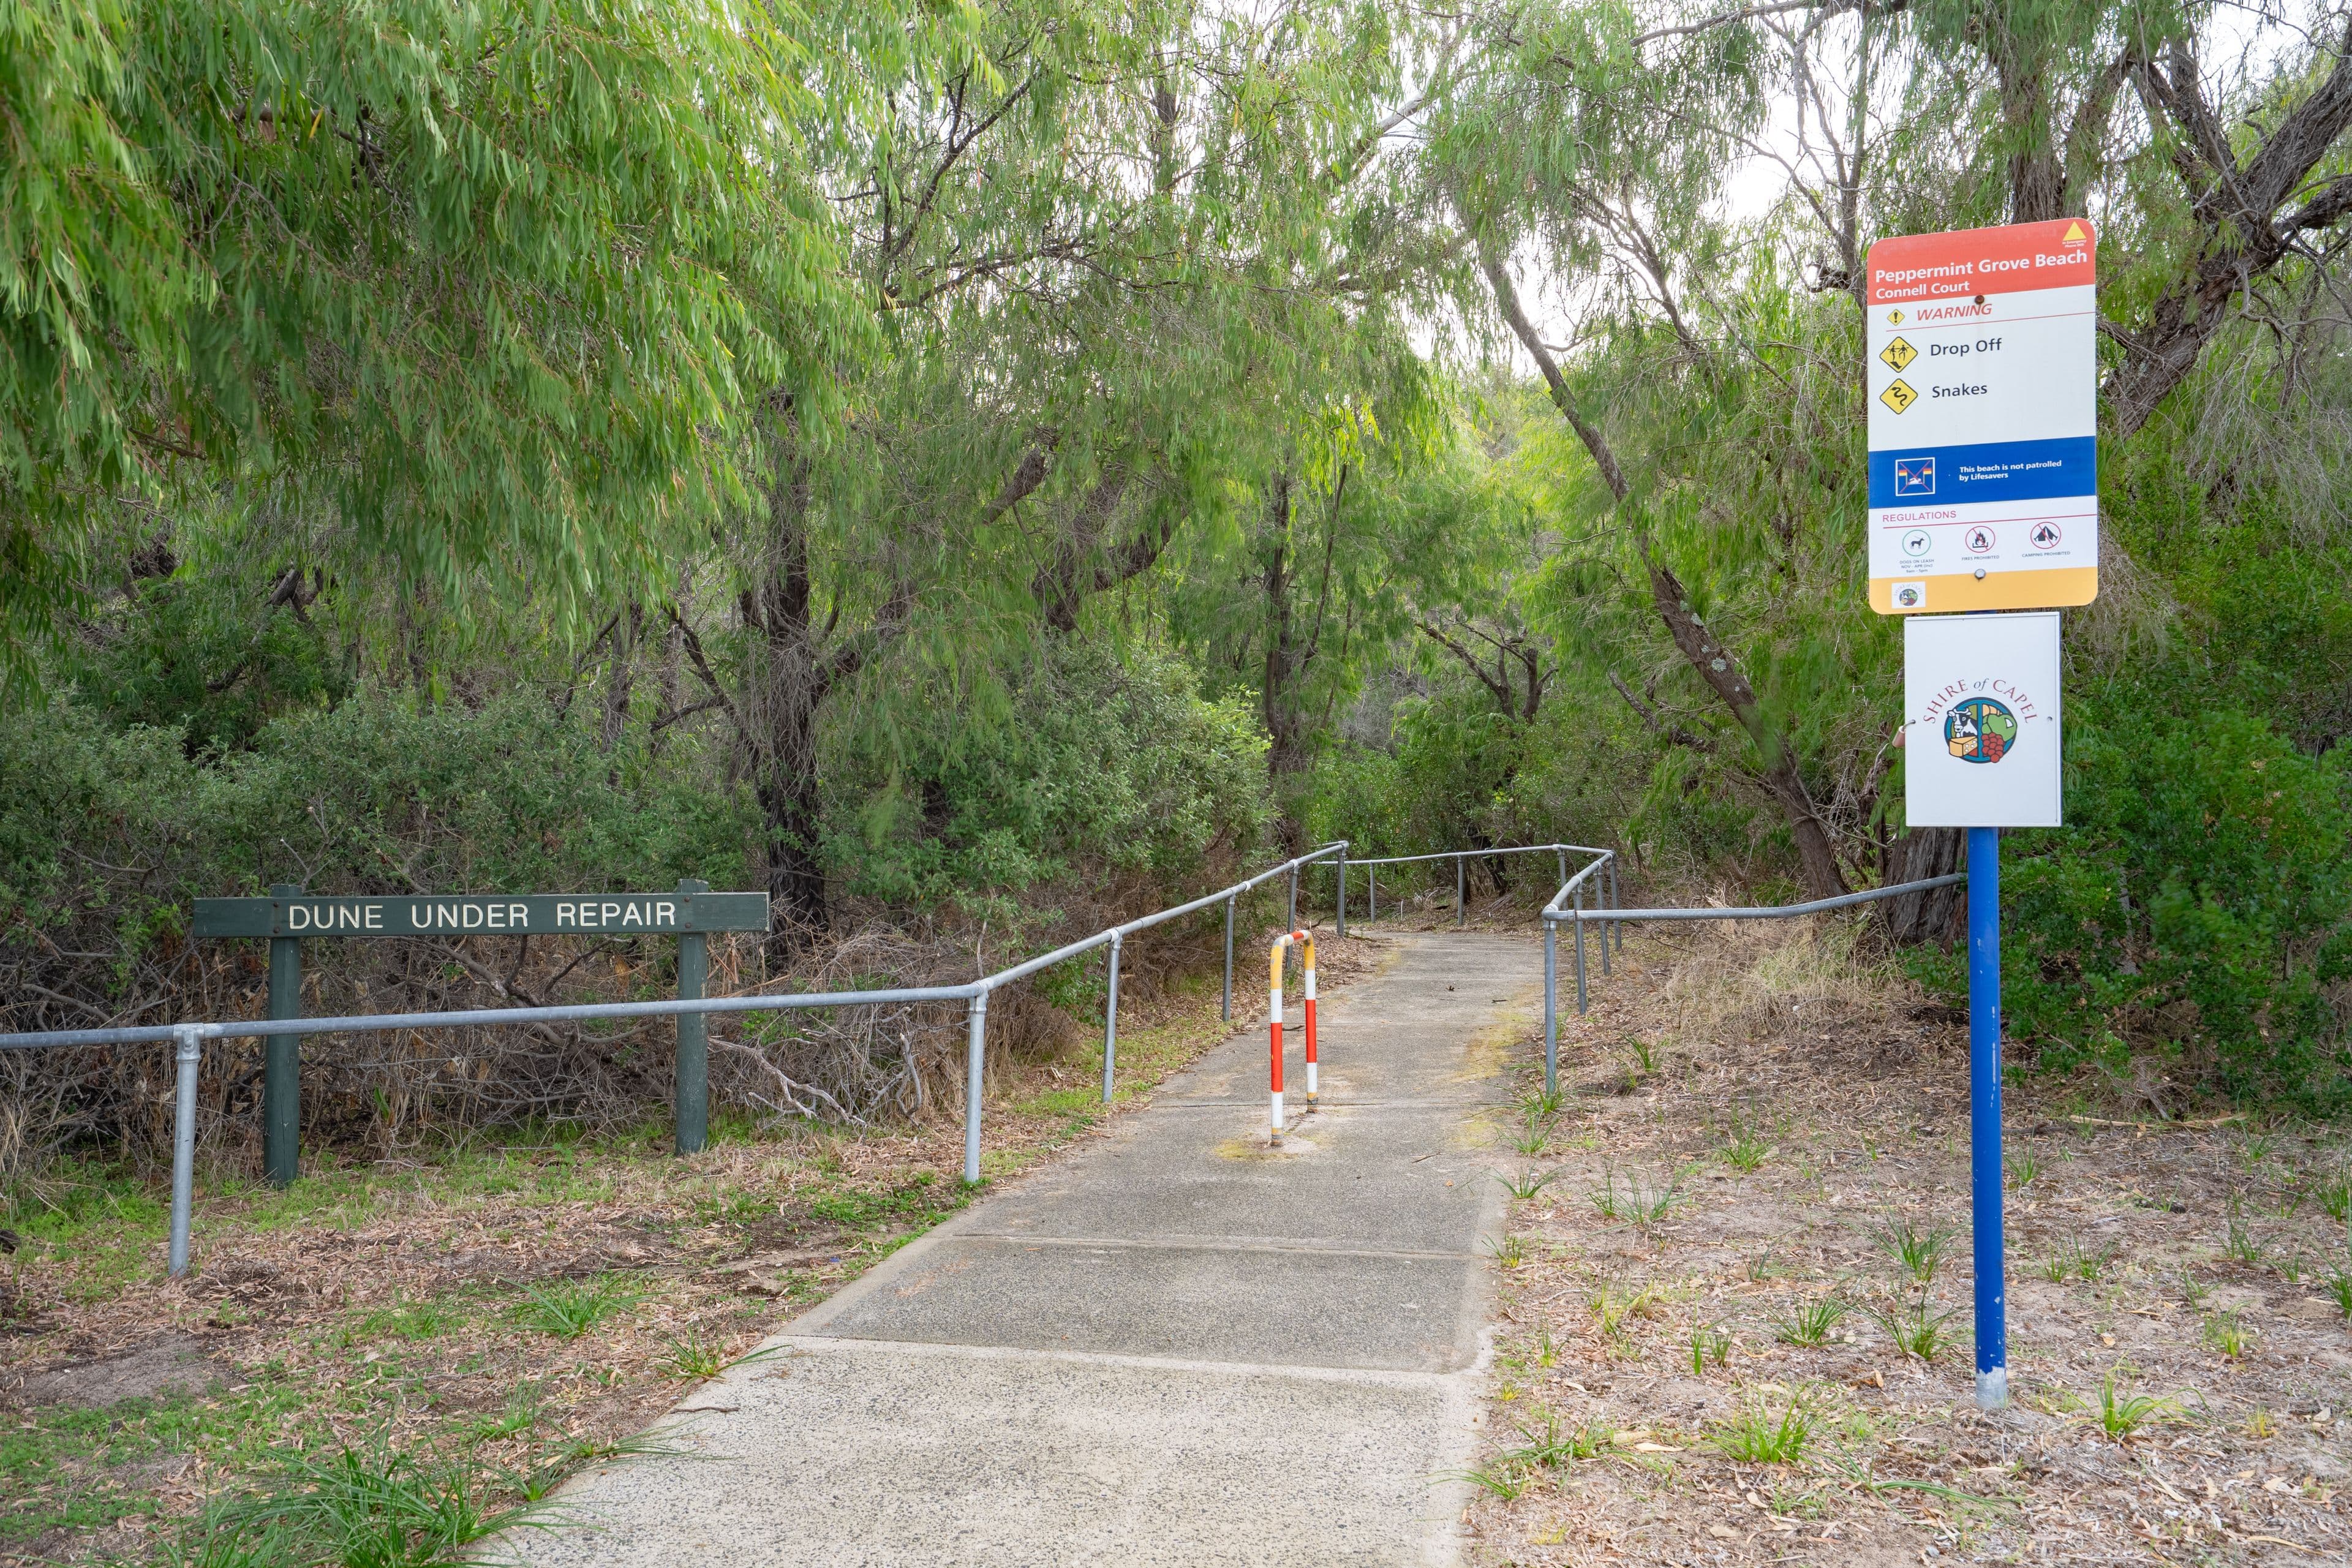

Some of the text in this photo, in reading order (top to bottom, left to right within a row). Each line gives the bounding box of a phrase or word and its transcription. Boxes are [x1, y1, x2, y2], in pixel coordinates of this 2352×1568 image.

[1875, 249, 2087, 284] Peppermint Grove Beach
[1875, 281, 1970, 300] Connell Court
[1917, 304, 1992, 321] WARNING
[1931, 337, 2002, 356] Drop Off
[1932, 383, 1988, 398] Snakes
[2026, 460, 2062, 470] patrolled
[1882, 510, 1956, 522] REGULATIONS
[1923, 678, 2038, 724] SHIRE of CAPEL
[288, 901, 676, 930] DUNE UNDER REPAIR
